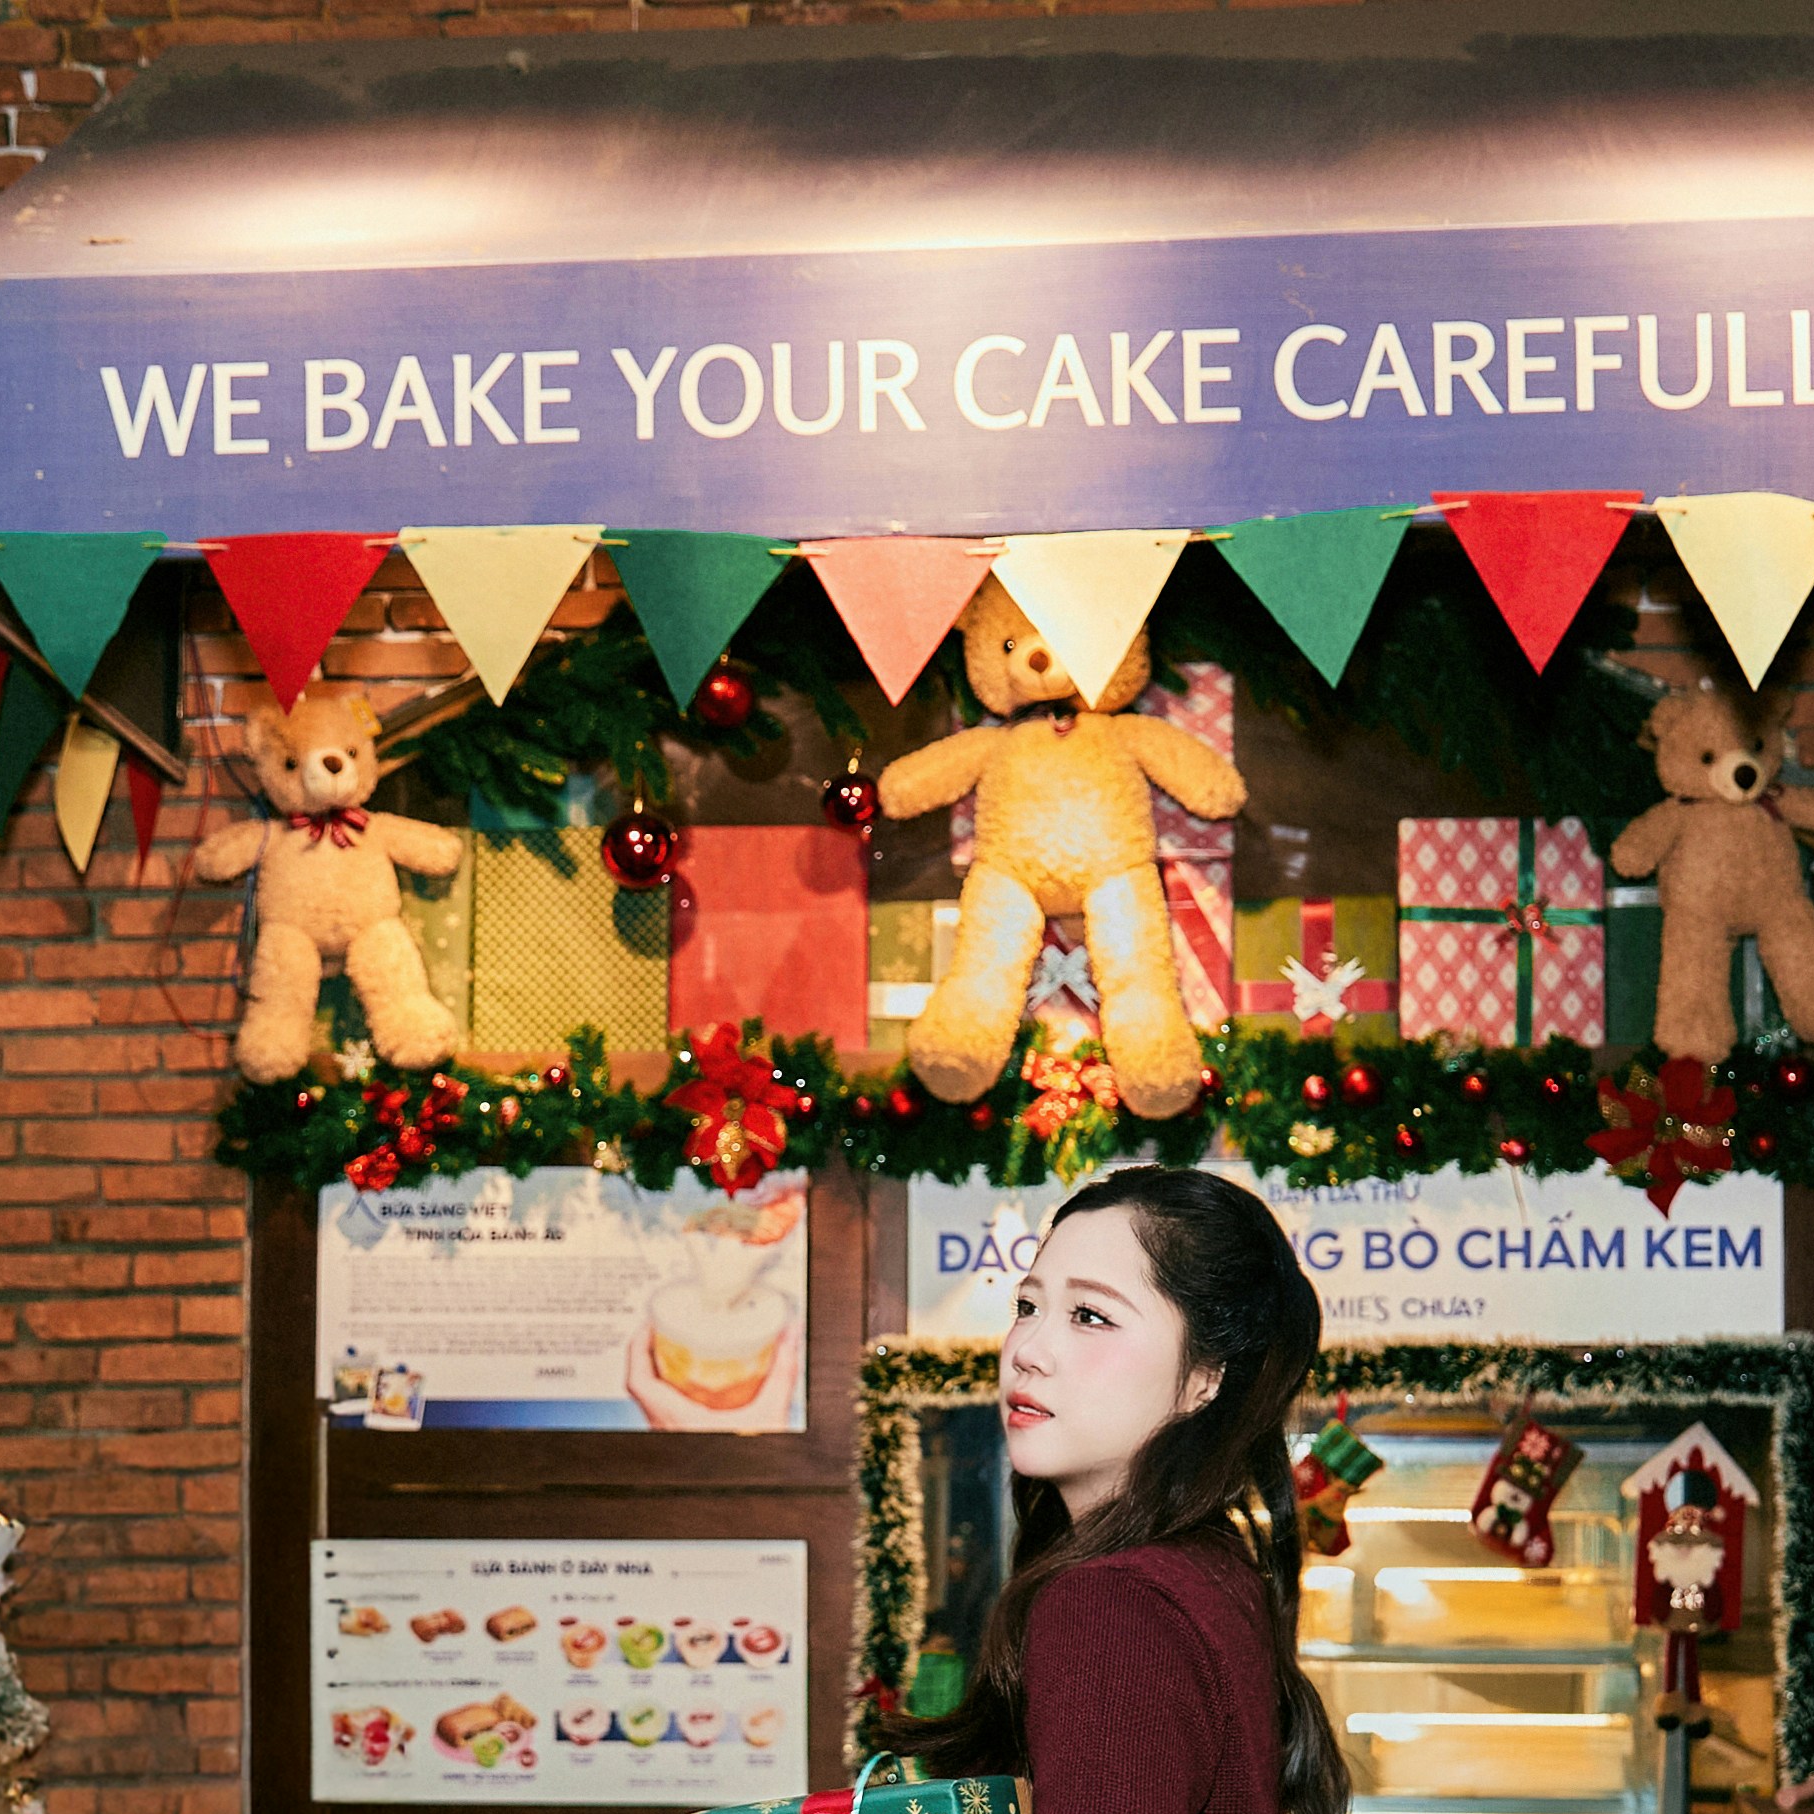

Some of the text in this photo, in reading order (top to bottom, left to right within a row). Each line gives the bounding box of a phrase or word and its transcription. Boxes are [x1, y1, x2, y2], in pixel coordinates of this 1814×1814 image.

[101, 360, 269, 457] WE
[305, 351, 580, 452] BAKE
[612, 339, 927, 440] YOUR
[954, 328, 1241, 429] CAKE
[1364, 1217, 1438, 1270] BÒ
[1457, 1210, 1625, 1269] CHẤM
[1645, 1227, 1762, 1268] KEM
[1401, 1297, 1485, 1318] CHƯA?
